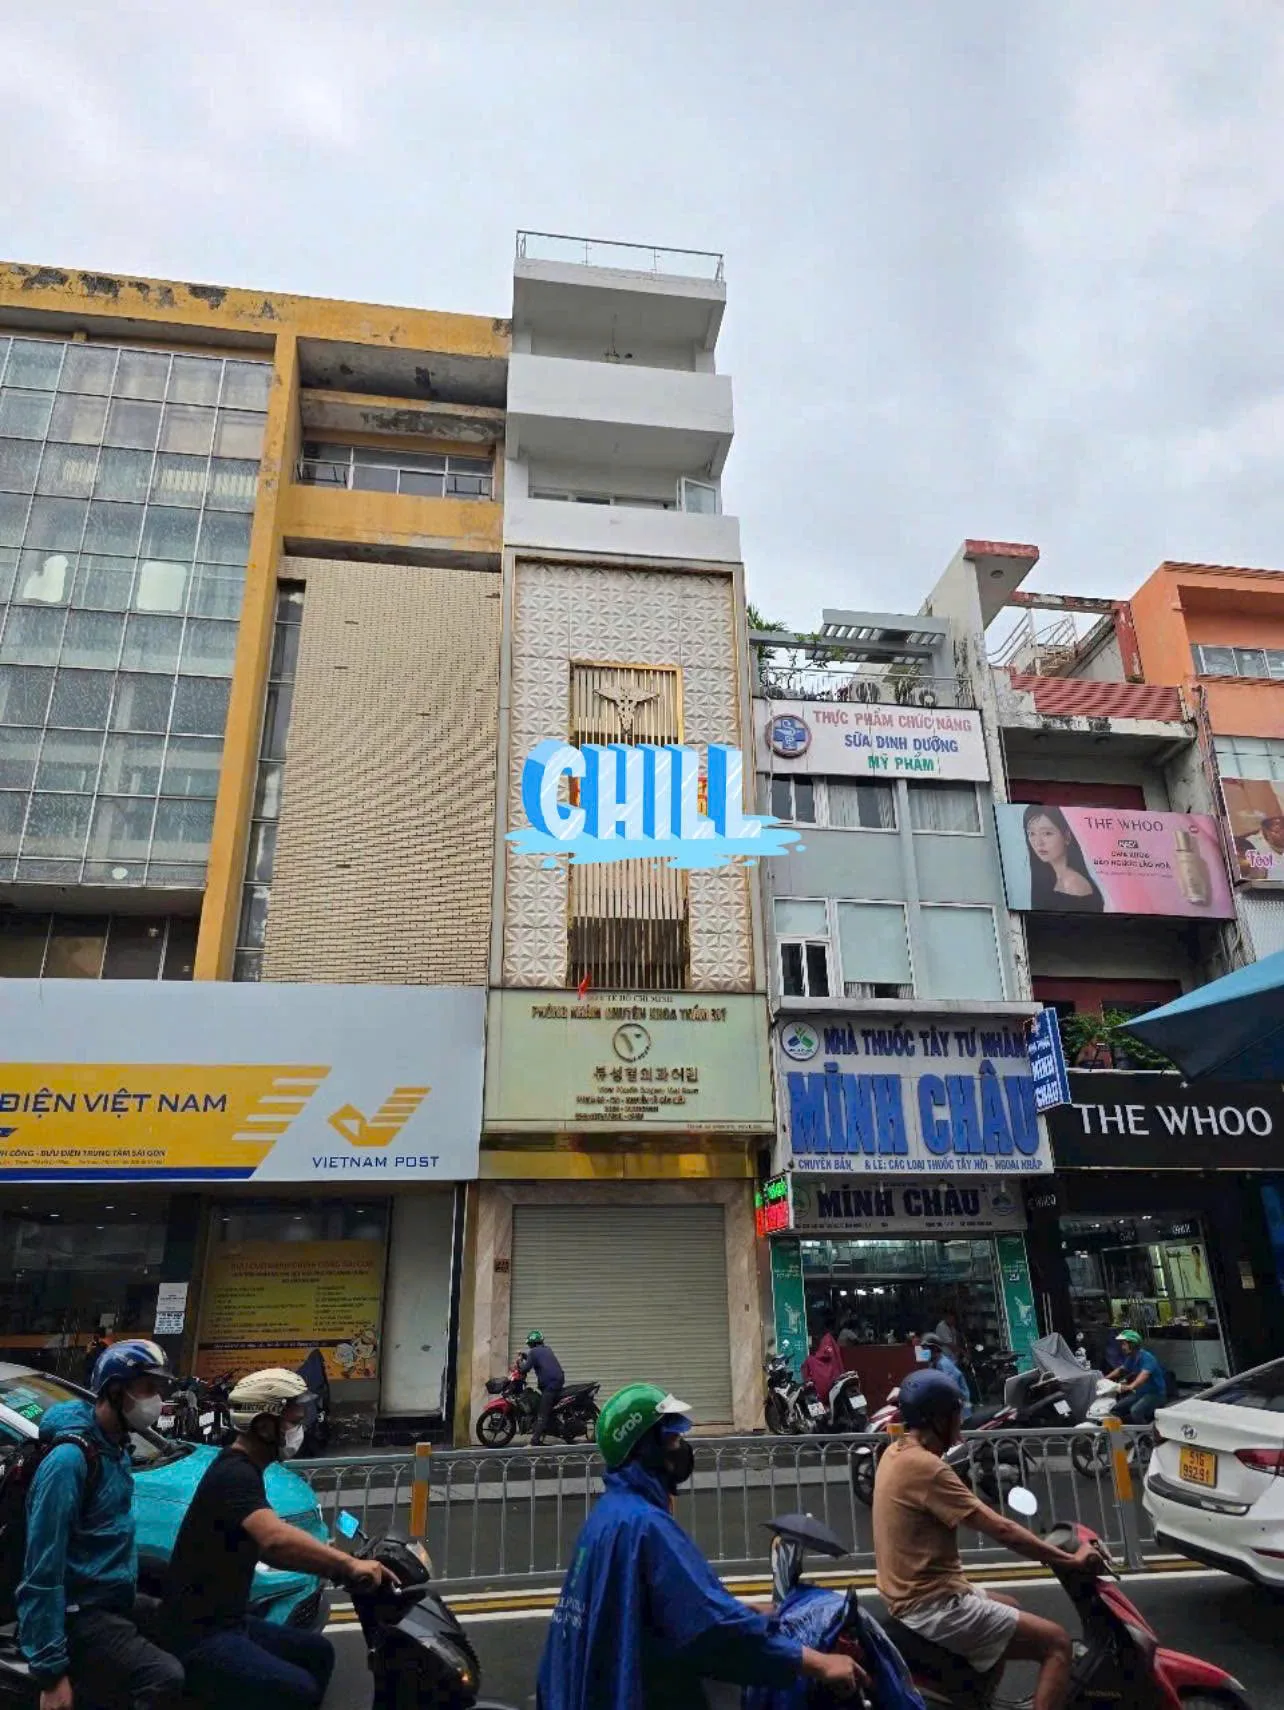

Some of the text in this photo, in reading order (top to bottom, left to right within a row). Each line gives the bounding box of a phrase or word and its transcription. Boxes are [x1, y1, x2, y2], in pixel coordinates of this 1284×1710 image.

[813, 709, 849, 725] THỰC
[855, 707, 894, 728] PHẨM
[898, 713, 933, 729] CHỨC
[844, 731, 959, 753] SỮA DINH DƯỠNG
[868, 752, 935, 772] MỸ PHẨM
[1083, 816, 1164, 832] THE WHOO
[861, 1022, 916, 1058] THUỐC
[919, 1025, 950, 1058] TÂY
[83, 1087, 152, 1119] VIỆT
[157, 1094, 228, 1112] NAM
[917, 1059, 1040, 1156] CHÂU
[1071, 1103, 1272, 1137] THE WHOO
[312, 1156, 439, 1169] VIETNAM POST
[612, 1411, 643, 1443] Grab
